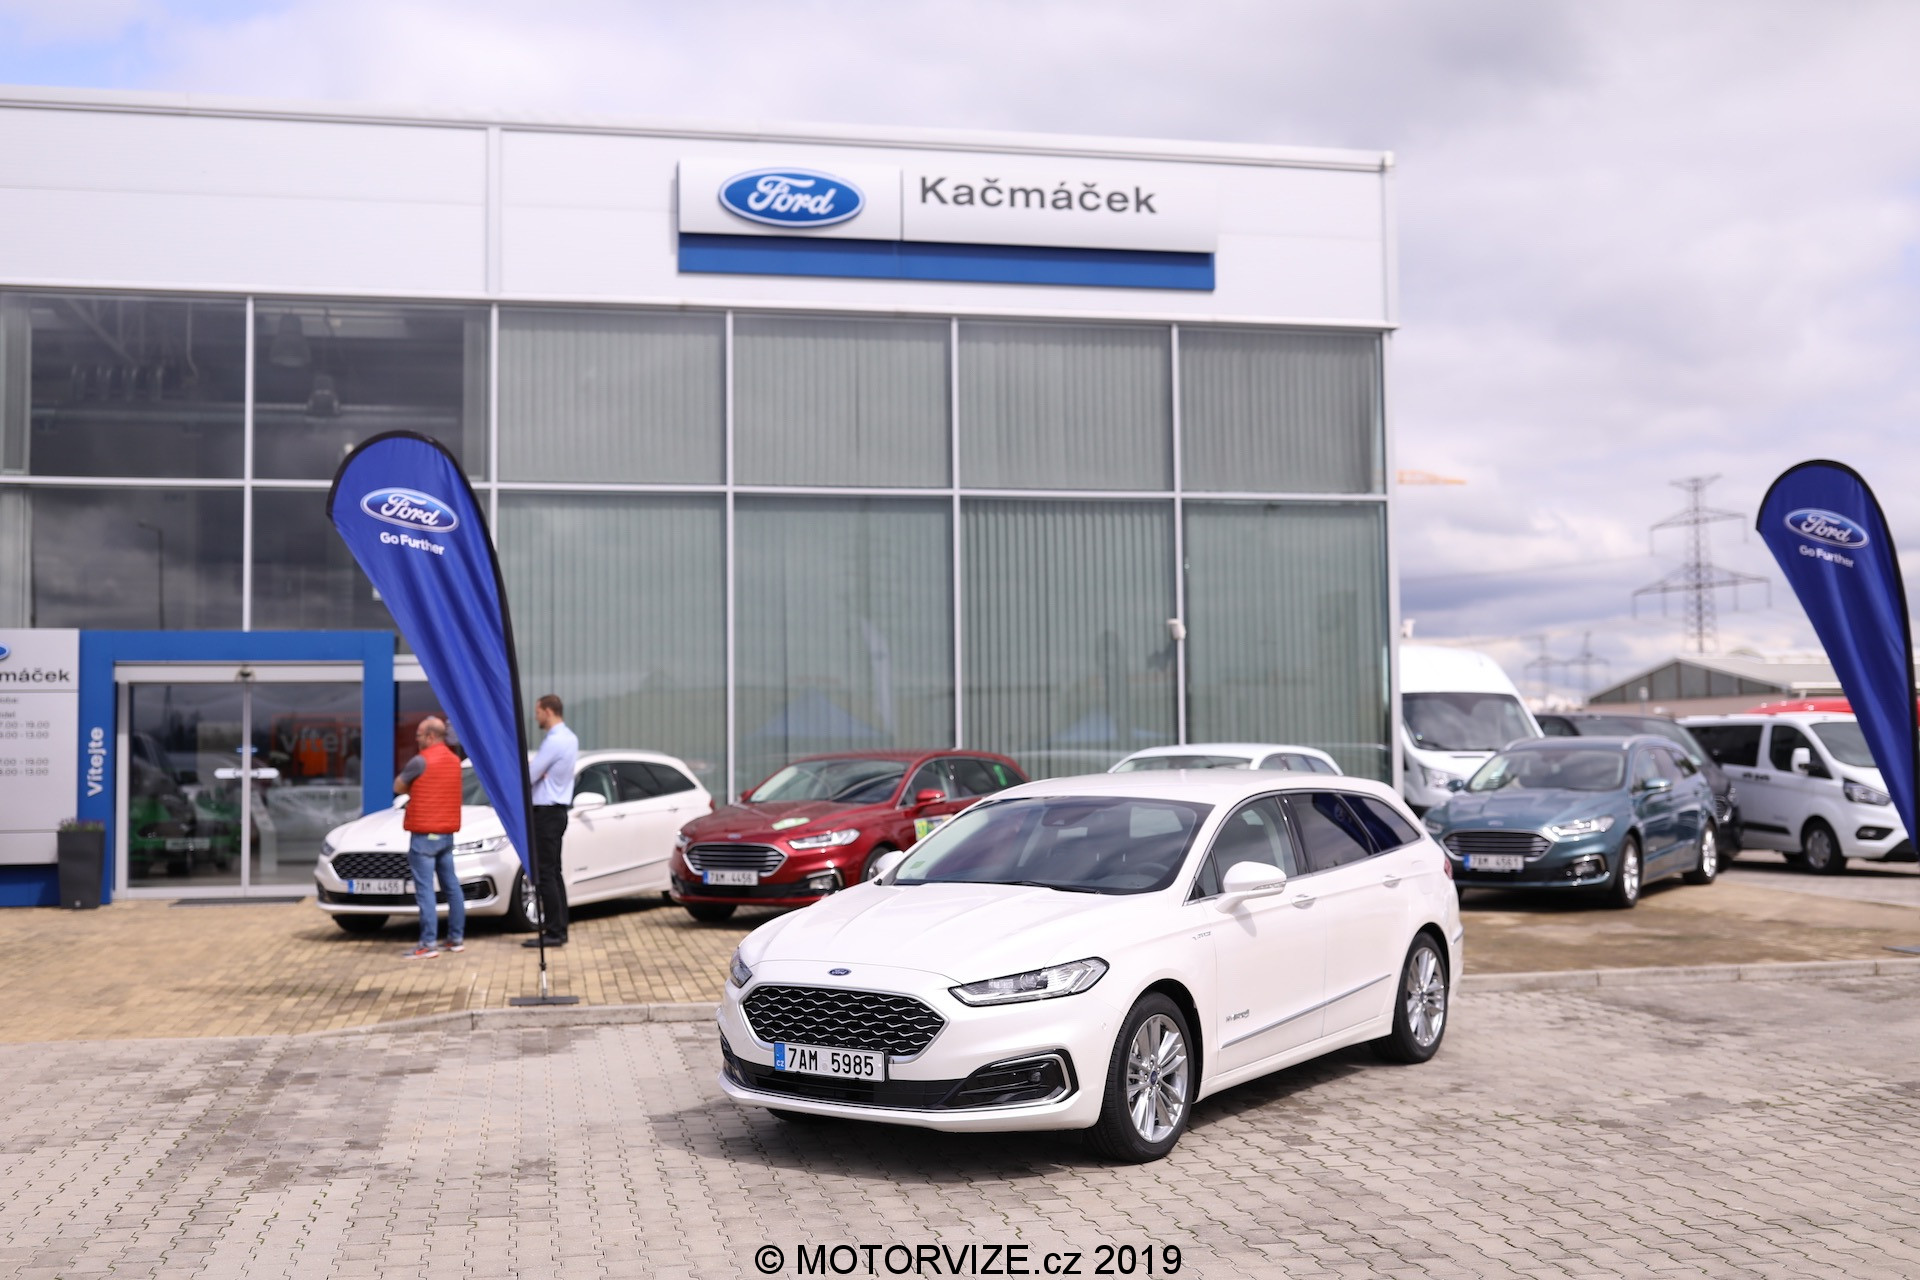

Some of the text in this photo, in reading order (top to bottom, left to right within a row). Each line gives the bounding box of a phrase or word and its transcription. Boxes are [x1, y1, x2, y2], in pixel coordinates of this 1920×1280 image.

[747, 175, 836, 216] Ford
[920, 175, 1158, 214] Kačmáček
[381, 493, 441, 526] Ford
[1801, 513, 1852, 543] Ford
[379, 531, 446, 556] Go Further
[1798, 544, 1855, 569] Go Further
[788, 1047, 818, 1071] 7AM
[831, 1052, 874, 1077] 5985
